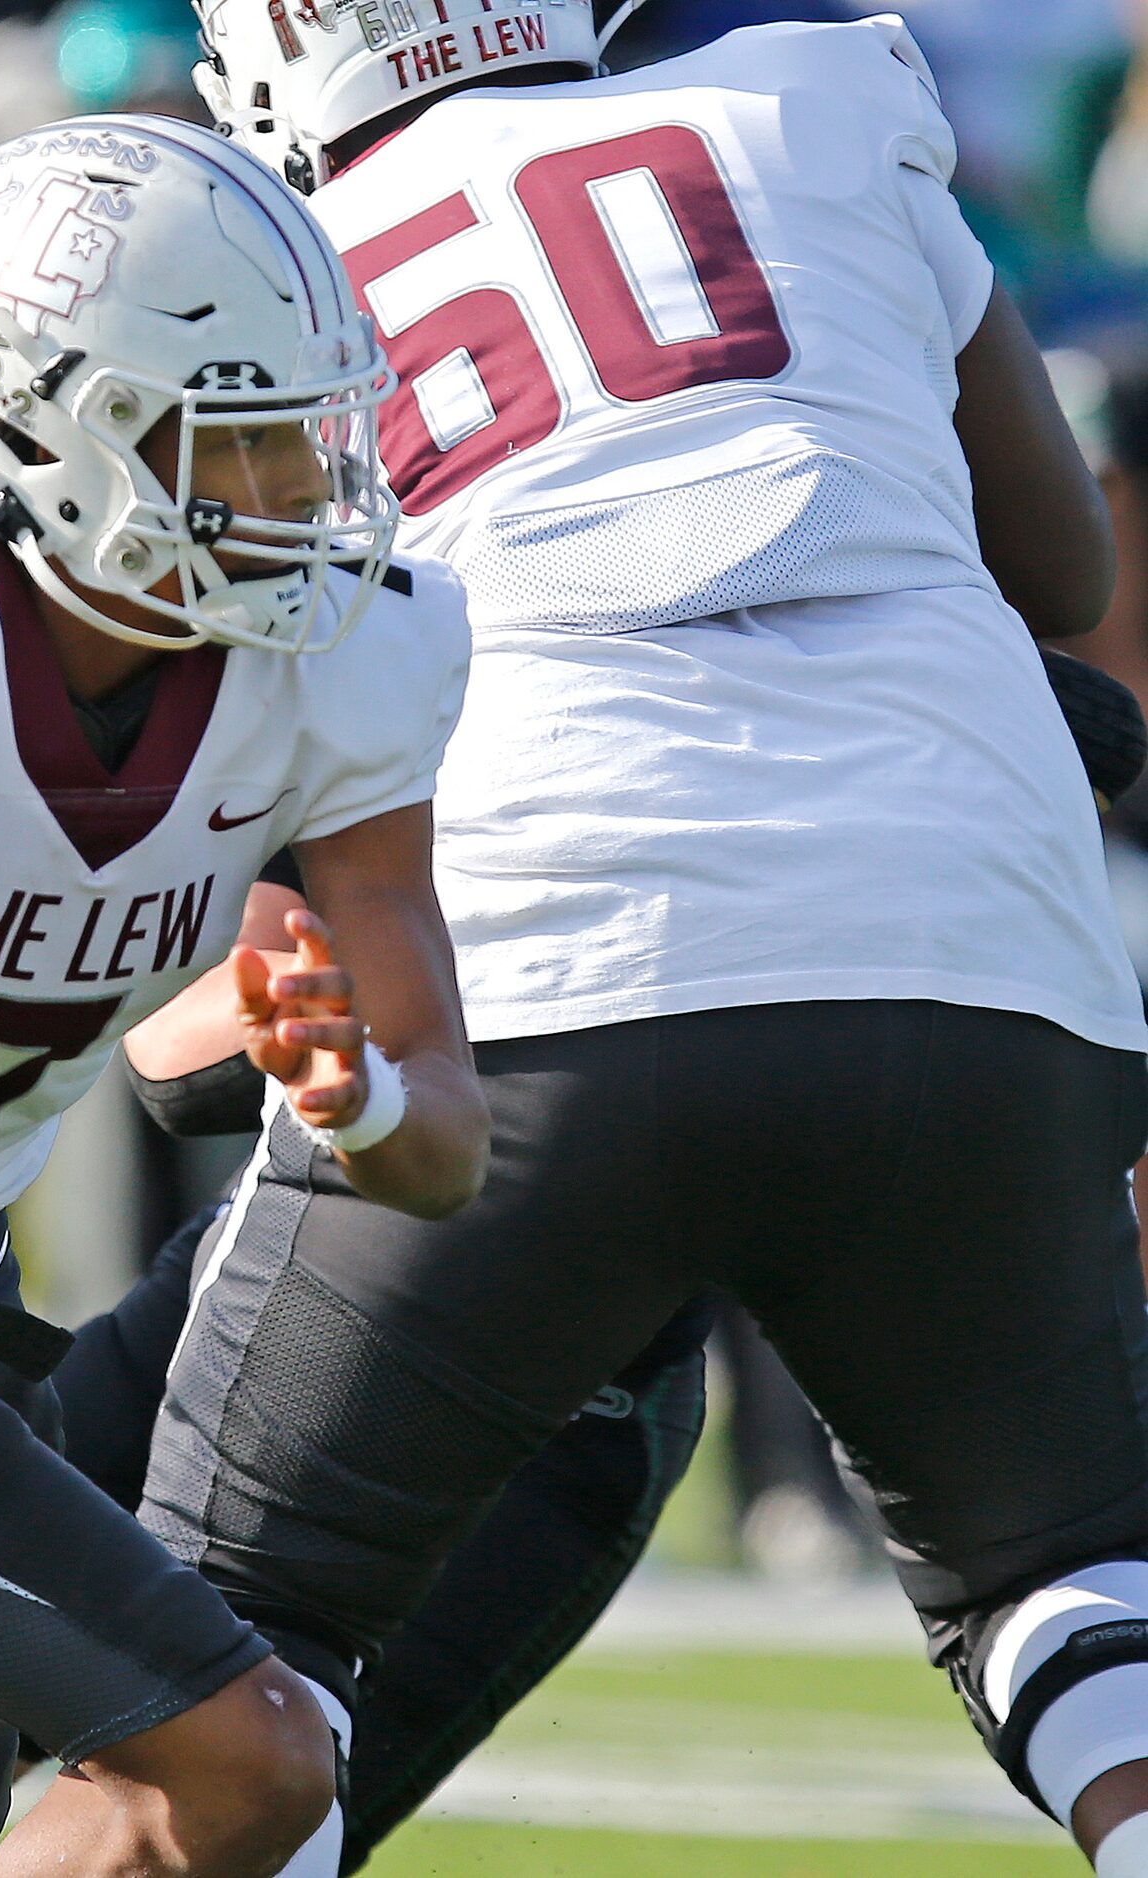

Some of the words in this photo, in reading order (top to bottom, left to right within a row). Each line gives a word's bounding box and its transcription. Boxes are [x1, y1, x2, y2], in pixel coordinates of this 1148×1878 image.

[387, 33, 463, 90] THE
[473, 12, 548, 63] LEW
[336, 120, 801, 517] 60
[63, 872, 216, 983] LEW
